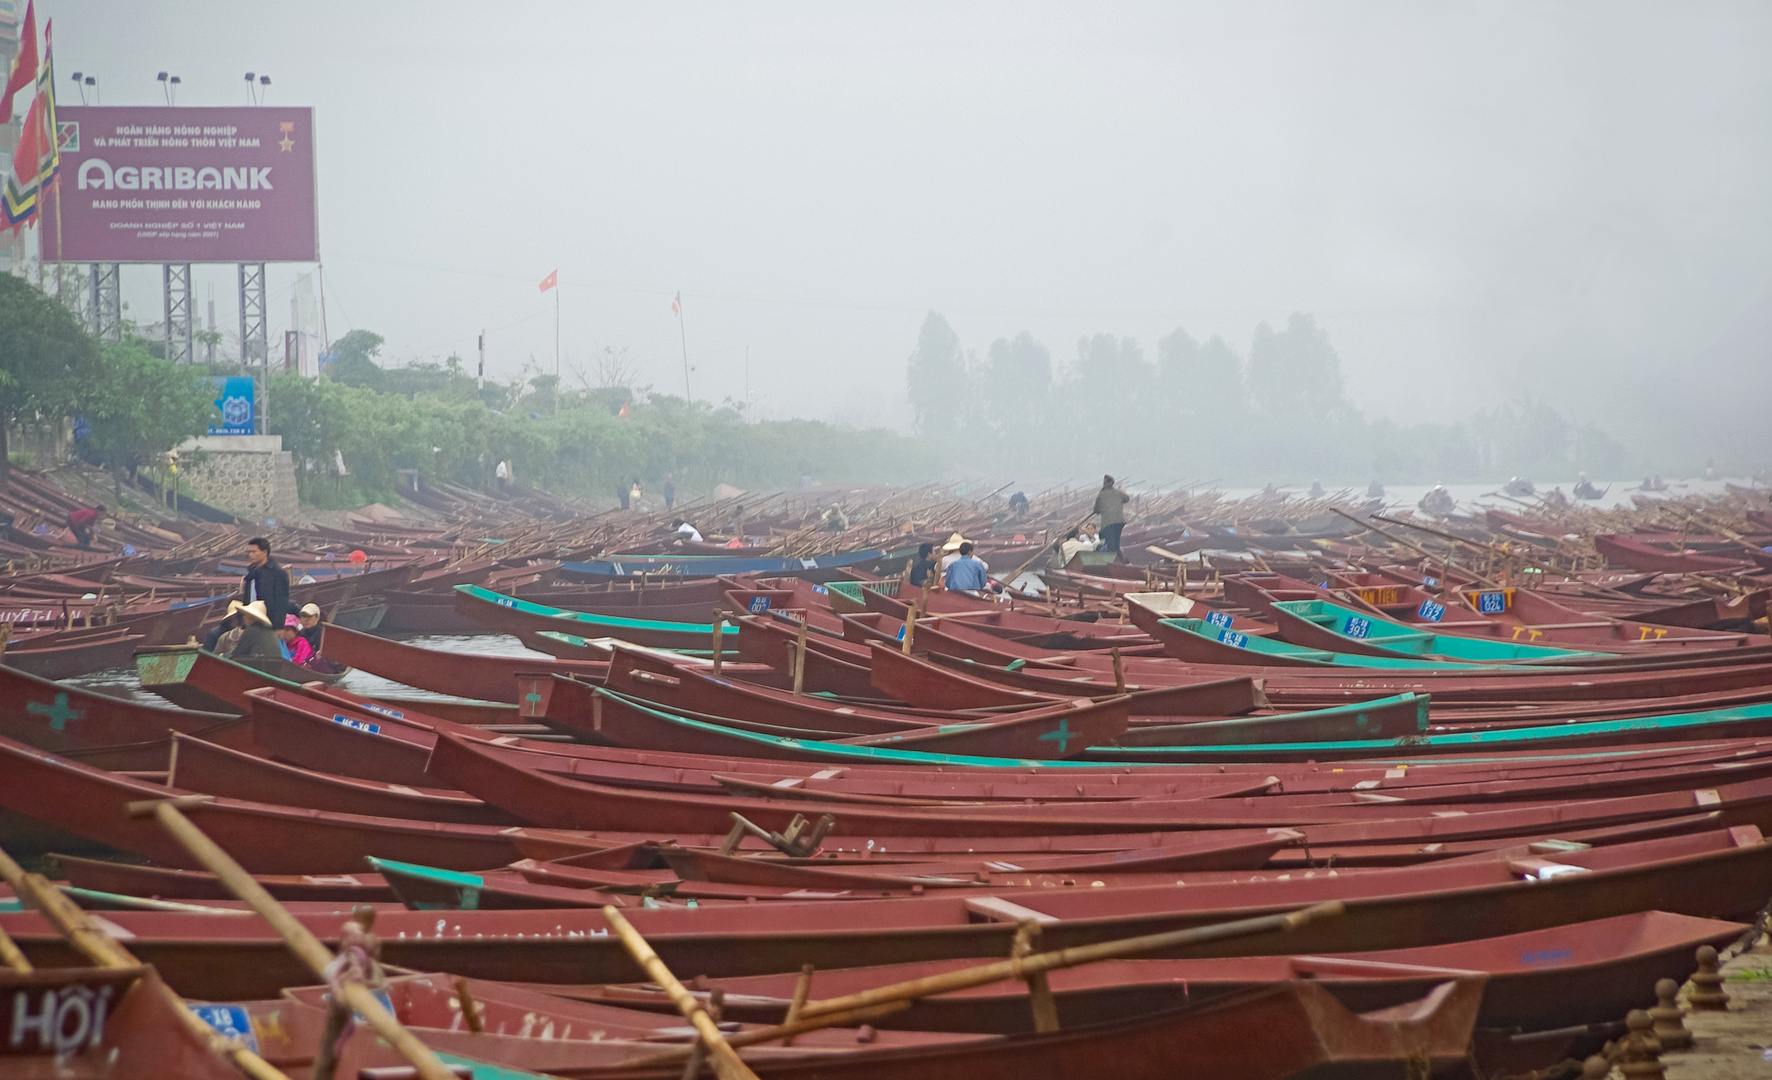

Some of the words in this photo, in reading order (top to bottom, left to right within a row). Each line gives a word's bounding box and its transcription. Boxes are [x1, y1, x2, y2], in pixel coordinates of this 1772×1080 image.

[116, 124, 143, 135] NGÂN
[145, 124, 171, 135] HÀNG
[174, 124, 201, 135] NÔNG
[203, 124, 237, 136] NGHIỆP
[94, 135, 106, 147] VÀ
[108, 136, 131, 147] PHÁT
[161, 136, 188, 147] NÔNG
[190, 136, 216, 147] THÔN
[218, 135, 237, 148] VIỆT
[239, 137, 260, 147] NAM
[77, 158, 273, 190] AGRIBANK
[92, 199, 119, 209] MANG
[206, 197, 235, 209] KHÁCH
[236, 197, 261, 209] HÀNG
[203, 221, 222, 230] VIỆT
[1422, 605, 1440, 620] 132
[1347, 624, 1366, 637] 393
